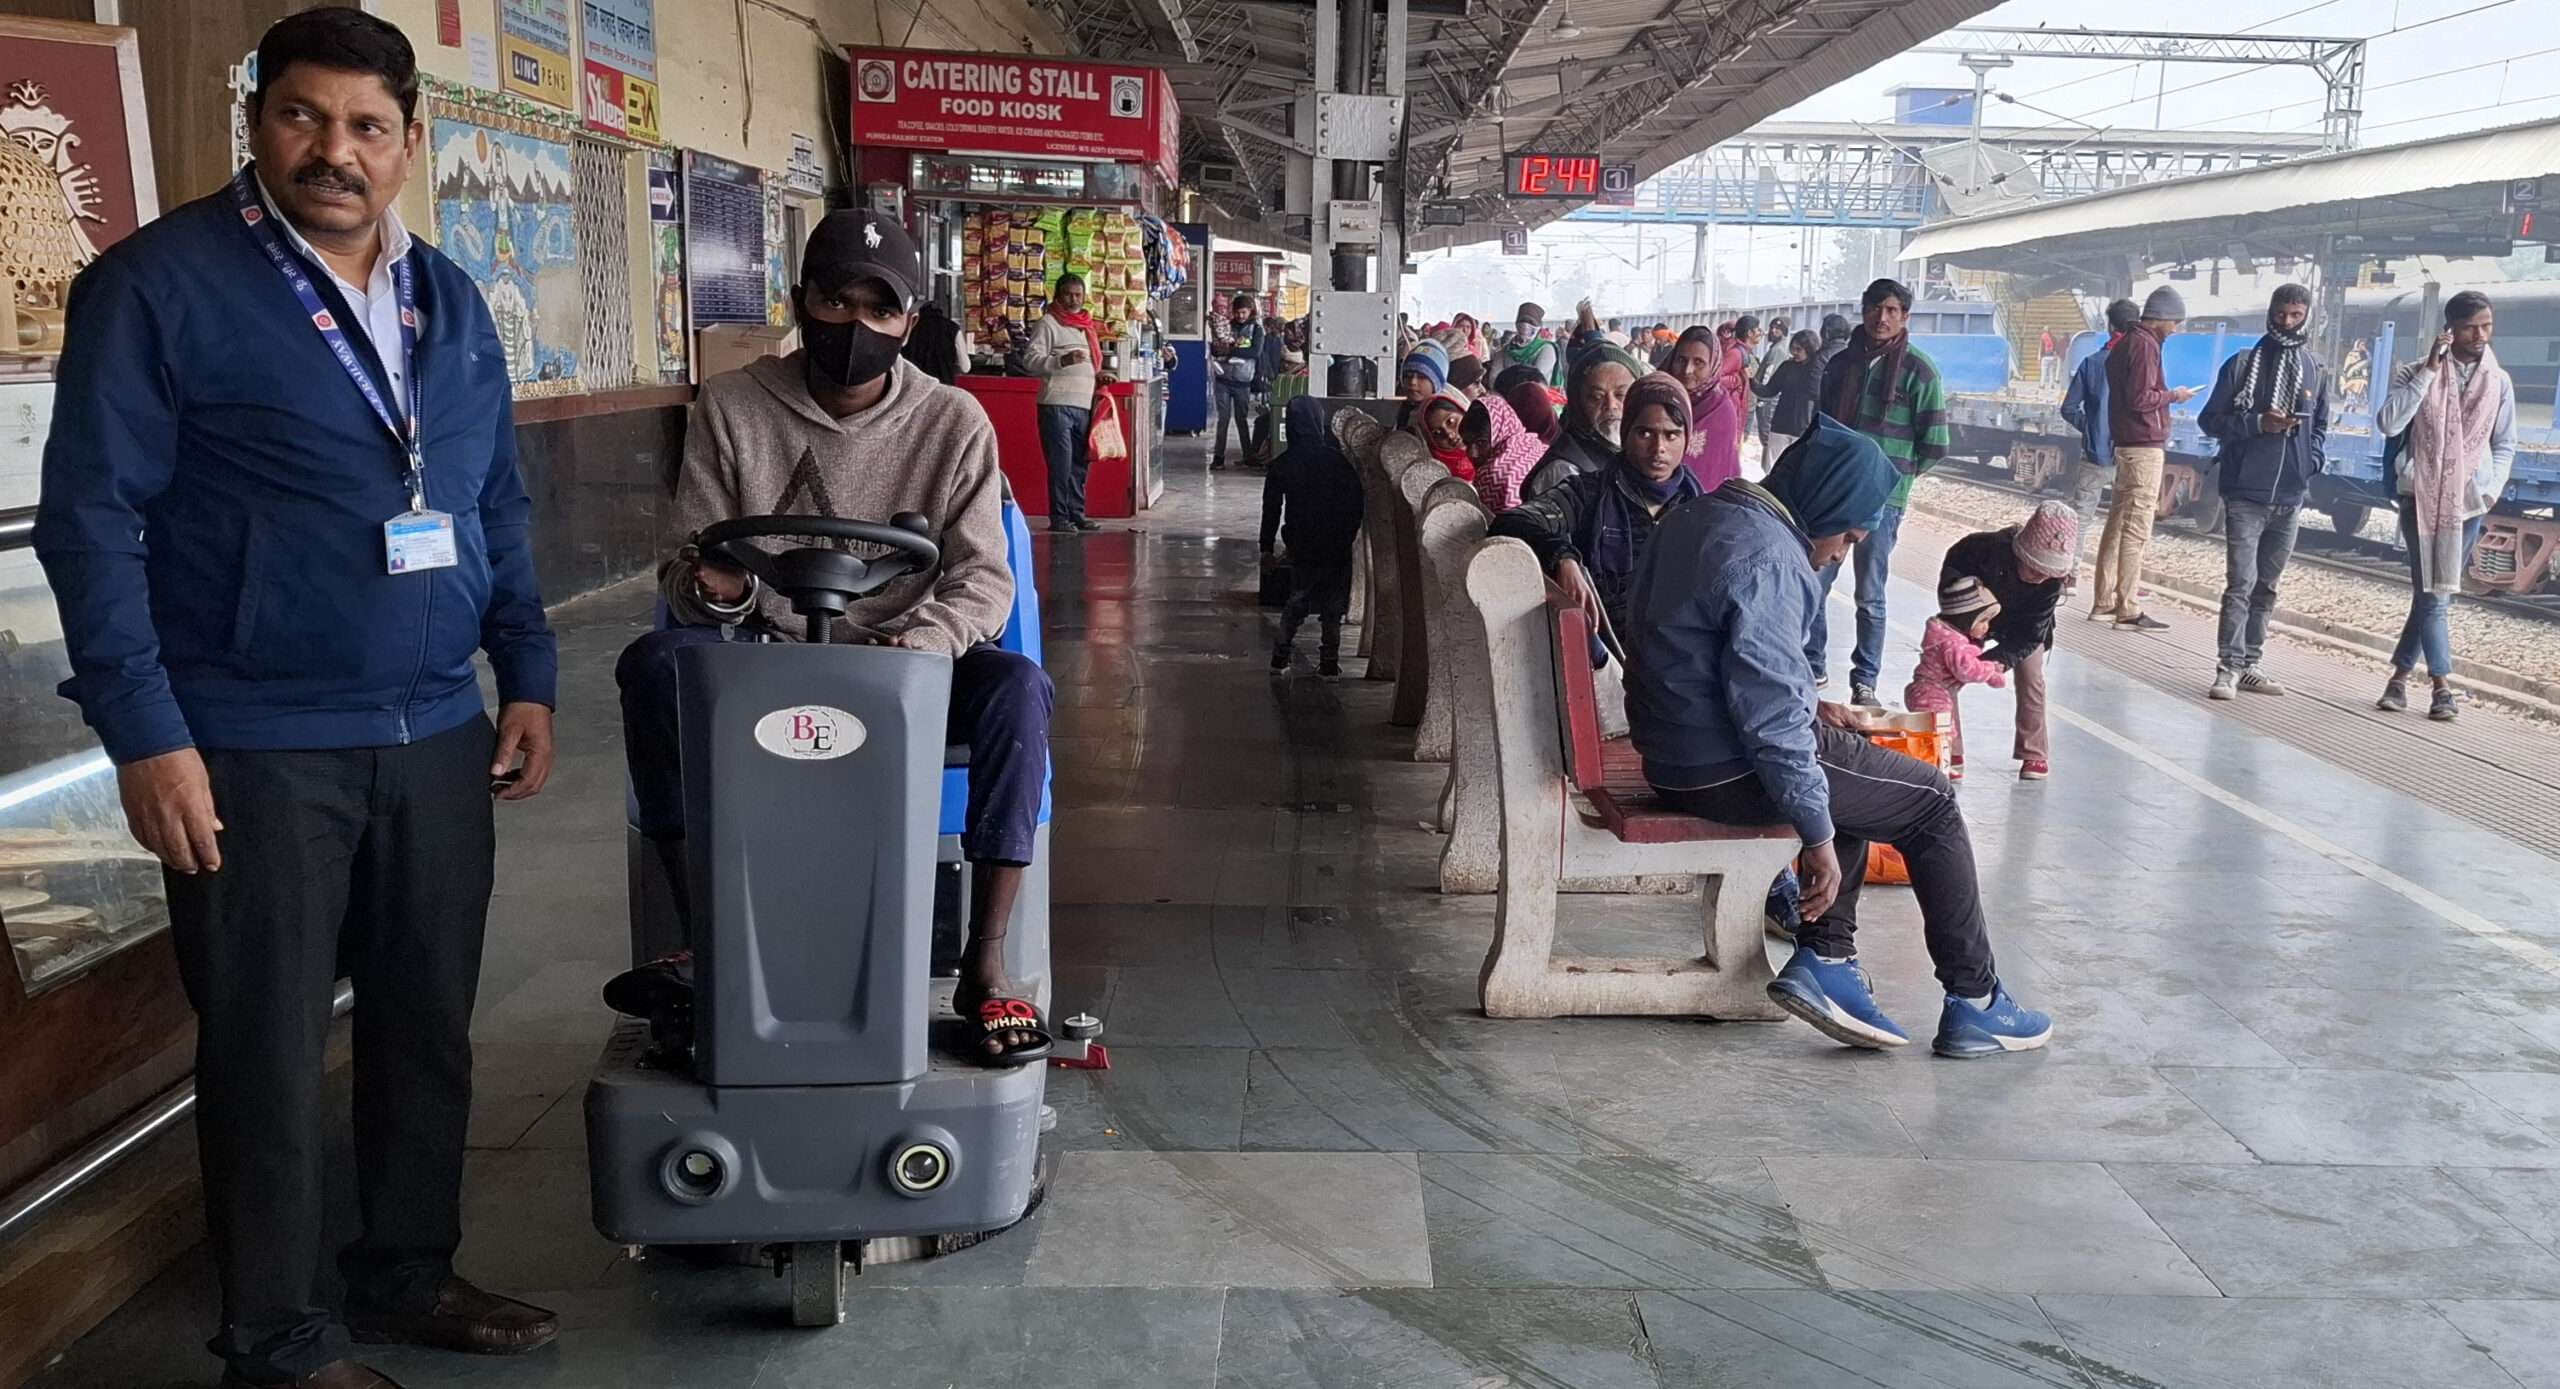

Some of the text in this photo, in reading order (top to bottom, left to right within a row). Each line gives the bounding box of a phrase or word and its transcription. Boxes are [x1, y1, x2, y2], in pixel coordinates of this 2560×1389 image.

[515, 55, 537, 82] LINC
[542, 67, 566, 91] PENS
[903, 60, 1021, 95] CATERING
[1029, 67, 1100, 101] STALL
[941, 97, 1062, 121] FOOD KIOSK
[1520, 156, 1596, 193] 12:44
[2517, 182, 2533, 198] 2
[1230, 262, 1252, 274] STALL
[980, 999, 1034, 1020] SO
[983, 1016, 1038, 1032] WHATT
